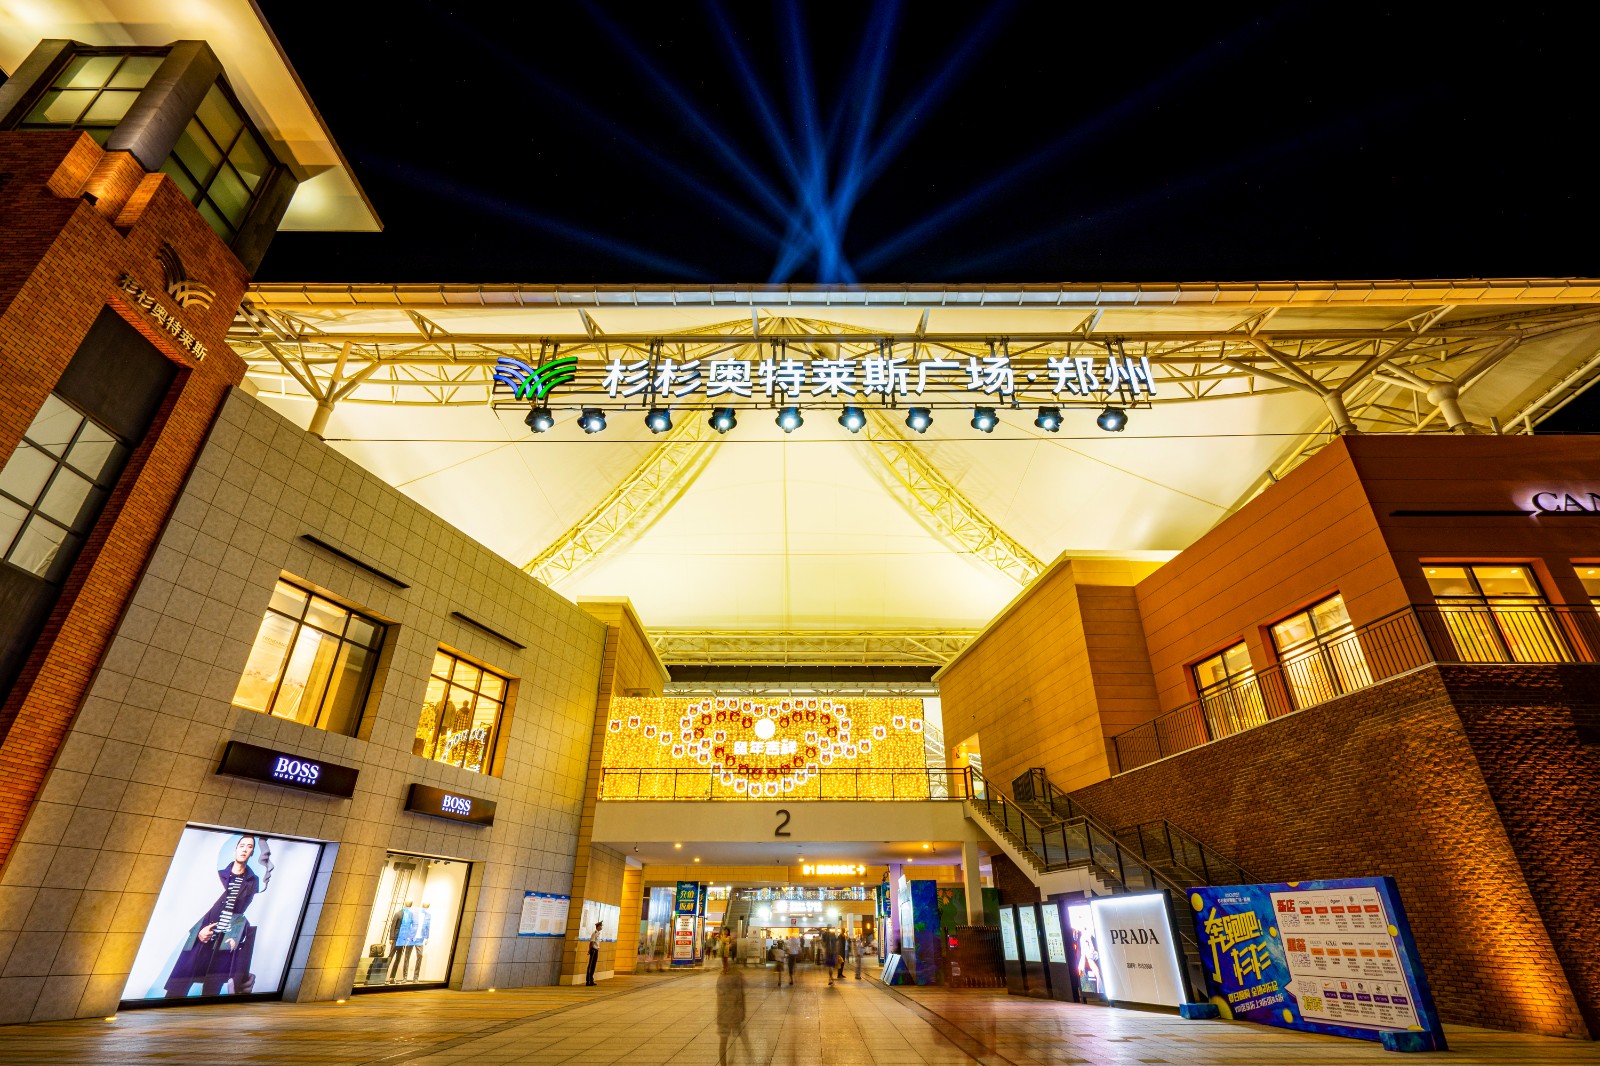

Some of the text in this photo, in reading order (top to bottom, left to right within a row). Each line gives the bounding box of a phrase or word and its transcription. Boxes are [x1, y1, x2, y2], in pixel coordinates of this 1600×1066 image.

[119, 275, 208, 361] 杉杉奥特莱斯
[274, 772, 294, 780] HUGO
[275, 757, 320, 779] BOSS
[442, 794, 471, 812] BOSS
[774, 809, 791, 837] 2
[1277, 899, 1296, 913] 新店
[1110, 928, 1160, 945] PRADA
